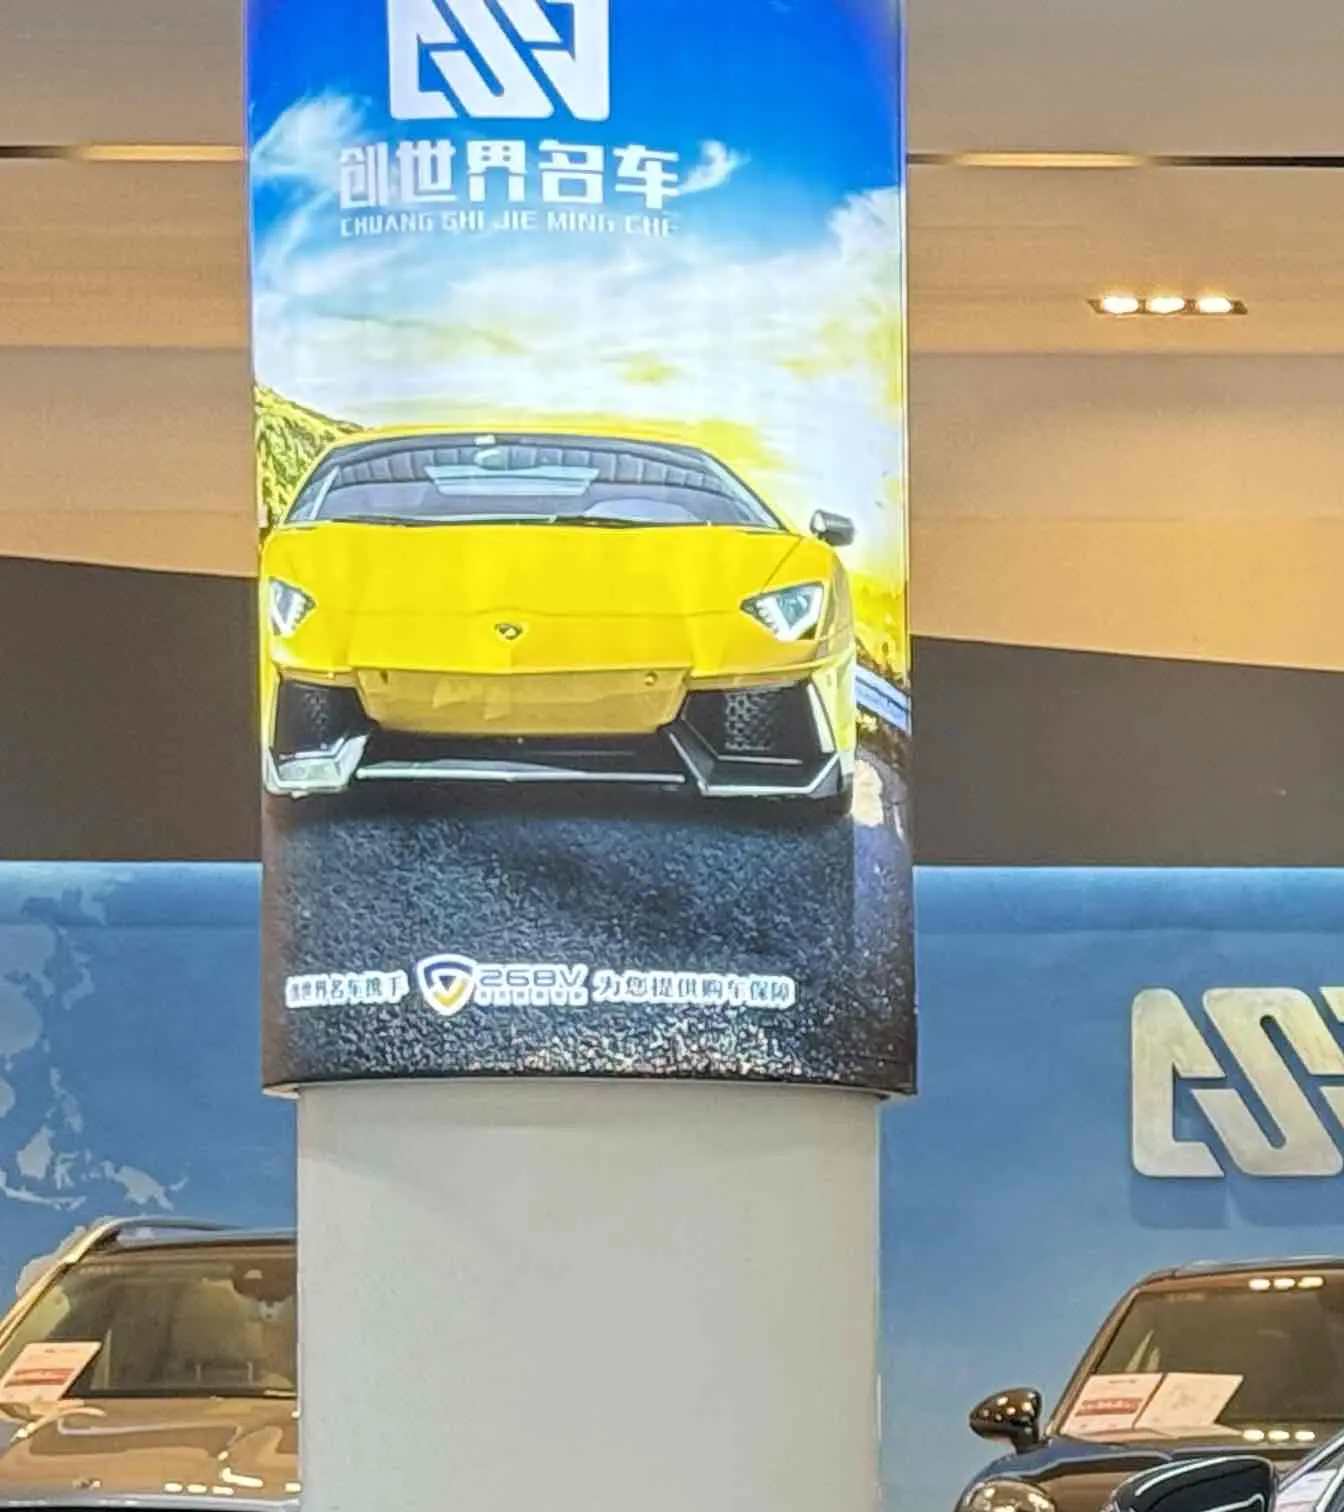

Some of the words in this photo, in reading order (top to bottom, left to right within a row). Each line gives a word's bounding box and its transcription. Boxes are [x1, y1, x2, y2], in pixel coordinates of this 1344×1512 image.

[339, 139, 681, 209] 创世界名车
[340, 211, 433, 237] CHUANG
[442, 210, 485, 231] SHI
[494, 209, 538, 230] JIE
[480, 968, 583, 987] 268V
